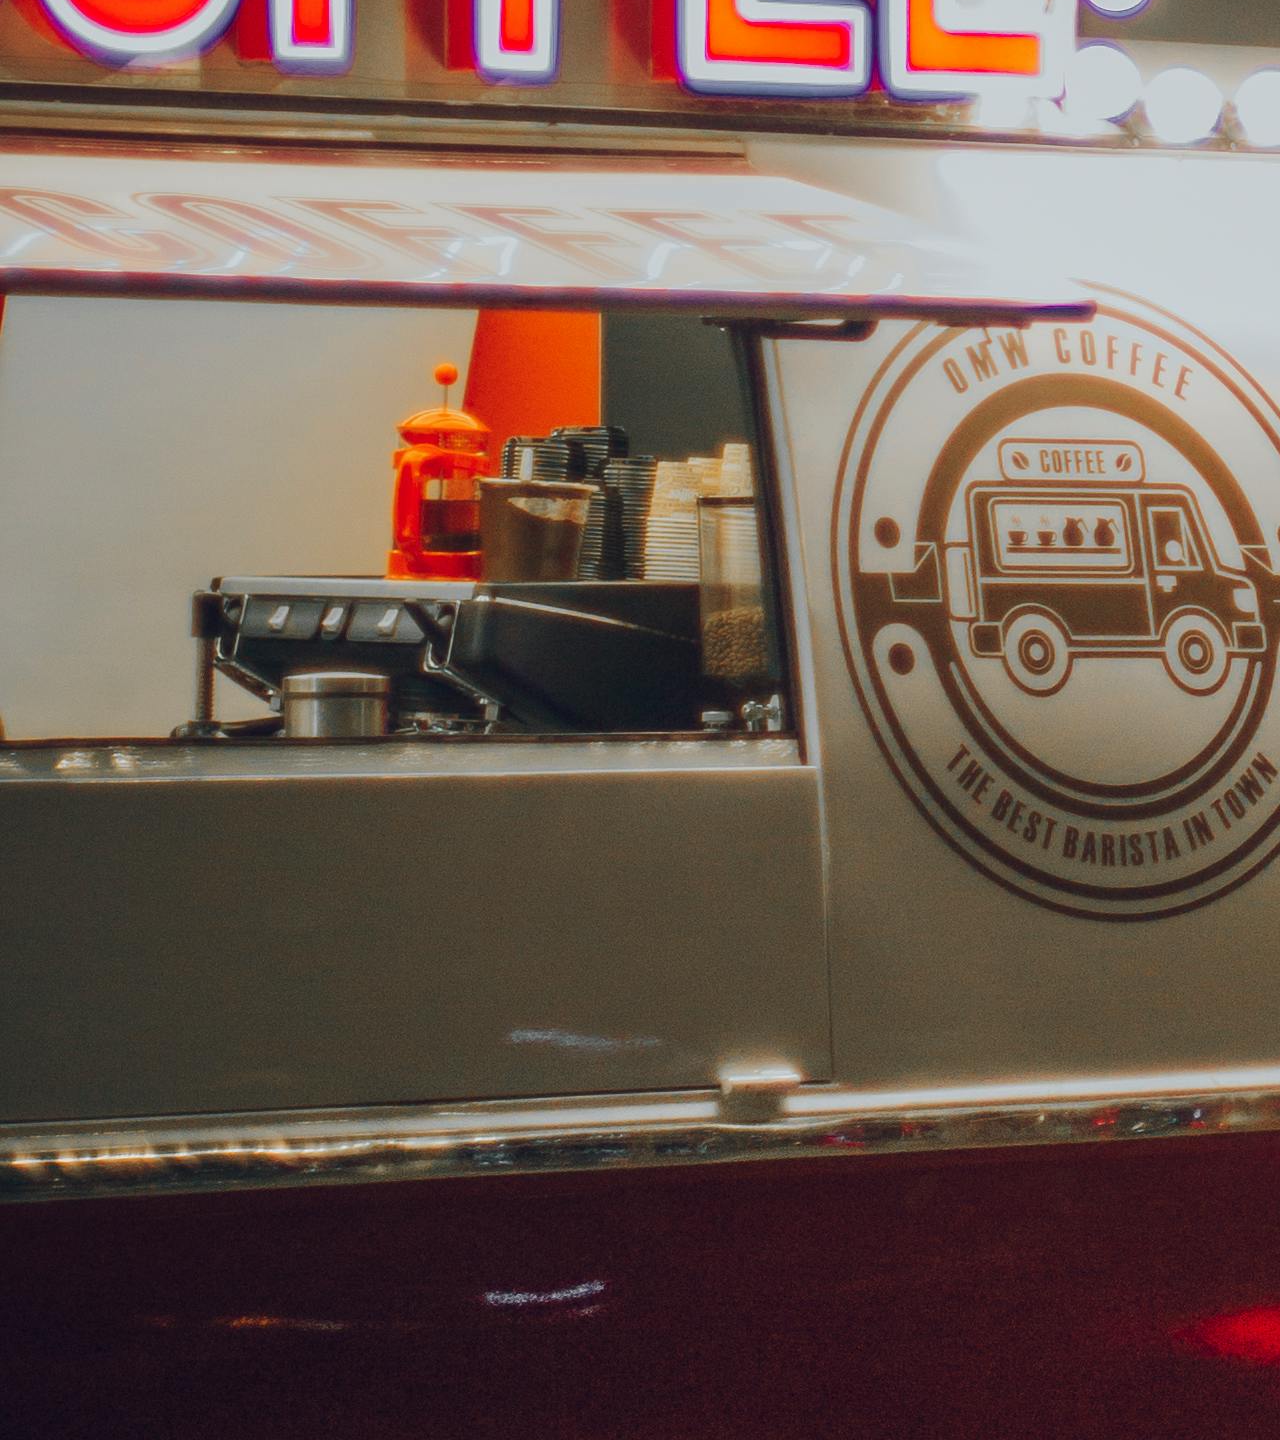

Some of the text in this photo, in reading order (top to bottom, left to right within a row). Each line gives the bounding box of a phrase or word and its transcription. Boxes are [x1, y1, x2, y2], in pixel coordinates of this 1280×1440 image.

[942, 328, 1193, 401] OMW COFFEE
[1039, 449, 1106, 474] COFFEE
[946, 743, 1279, 867] THE BEST BARISTA IN TOWN
